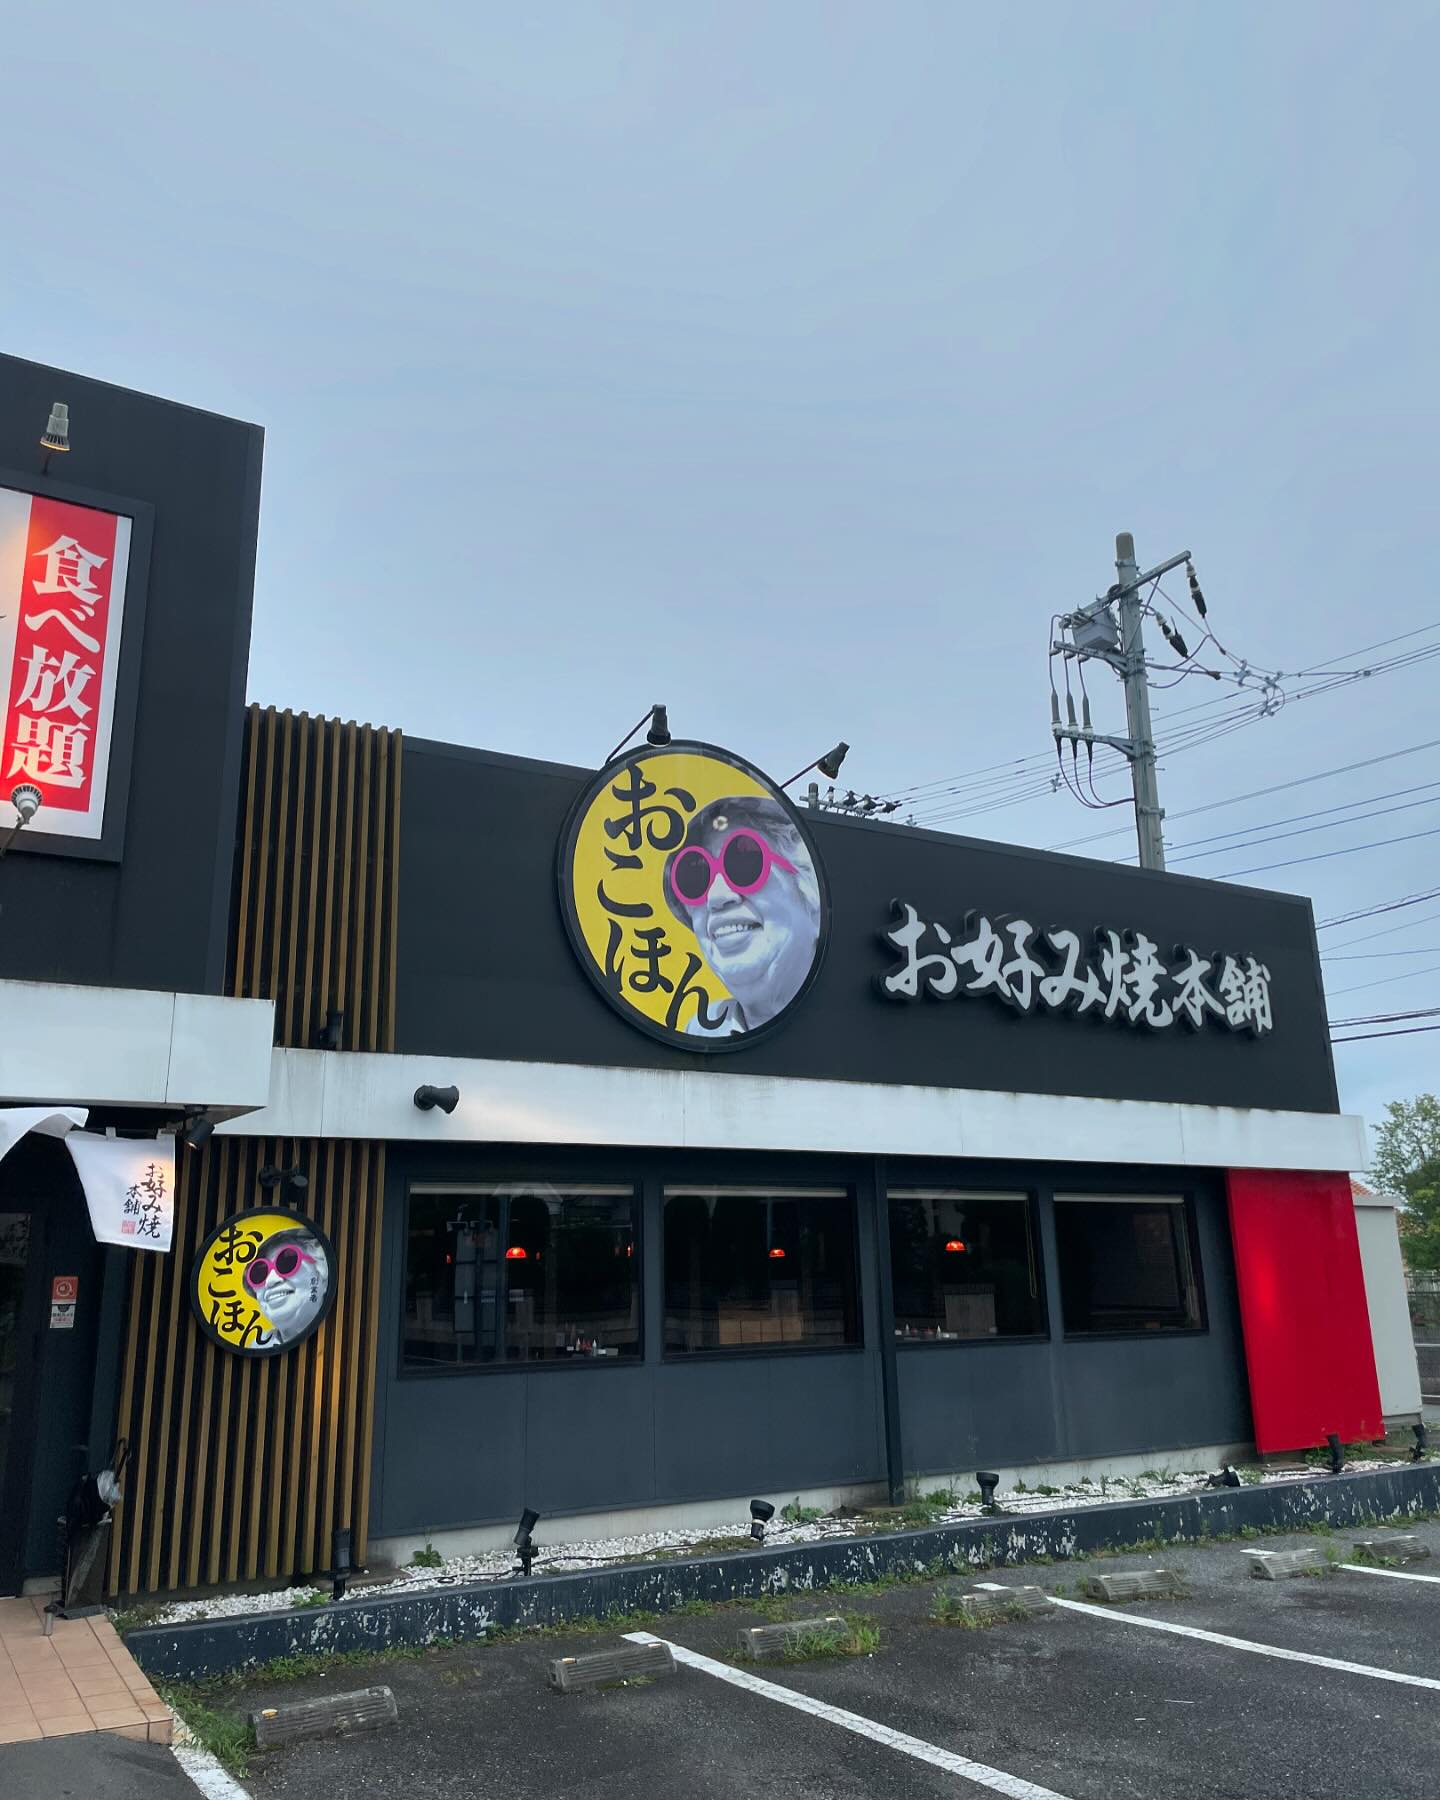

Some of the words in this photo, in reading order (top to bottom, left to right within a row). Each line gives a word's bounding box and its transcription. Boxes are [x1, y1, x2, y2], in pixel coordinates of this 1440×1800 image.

[6, 535, 108, 789] 食べ放題
[597, 762, 729, 1031] おこほん
[885, 903, 1273, 1033] お好み焼本舗
[123, 1184, 142, 1215] 本舗
[137, 1163, 167, 1238] お好み焼
[208, 1224, 273, 1347] おこほん
